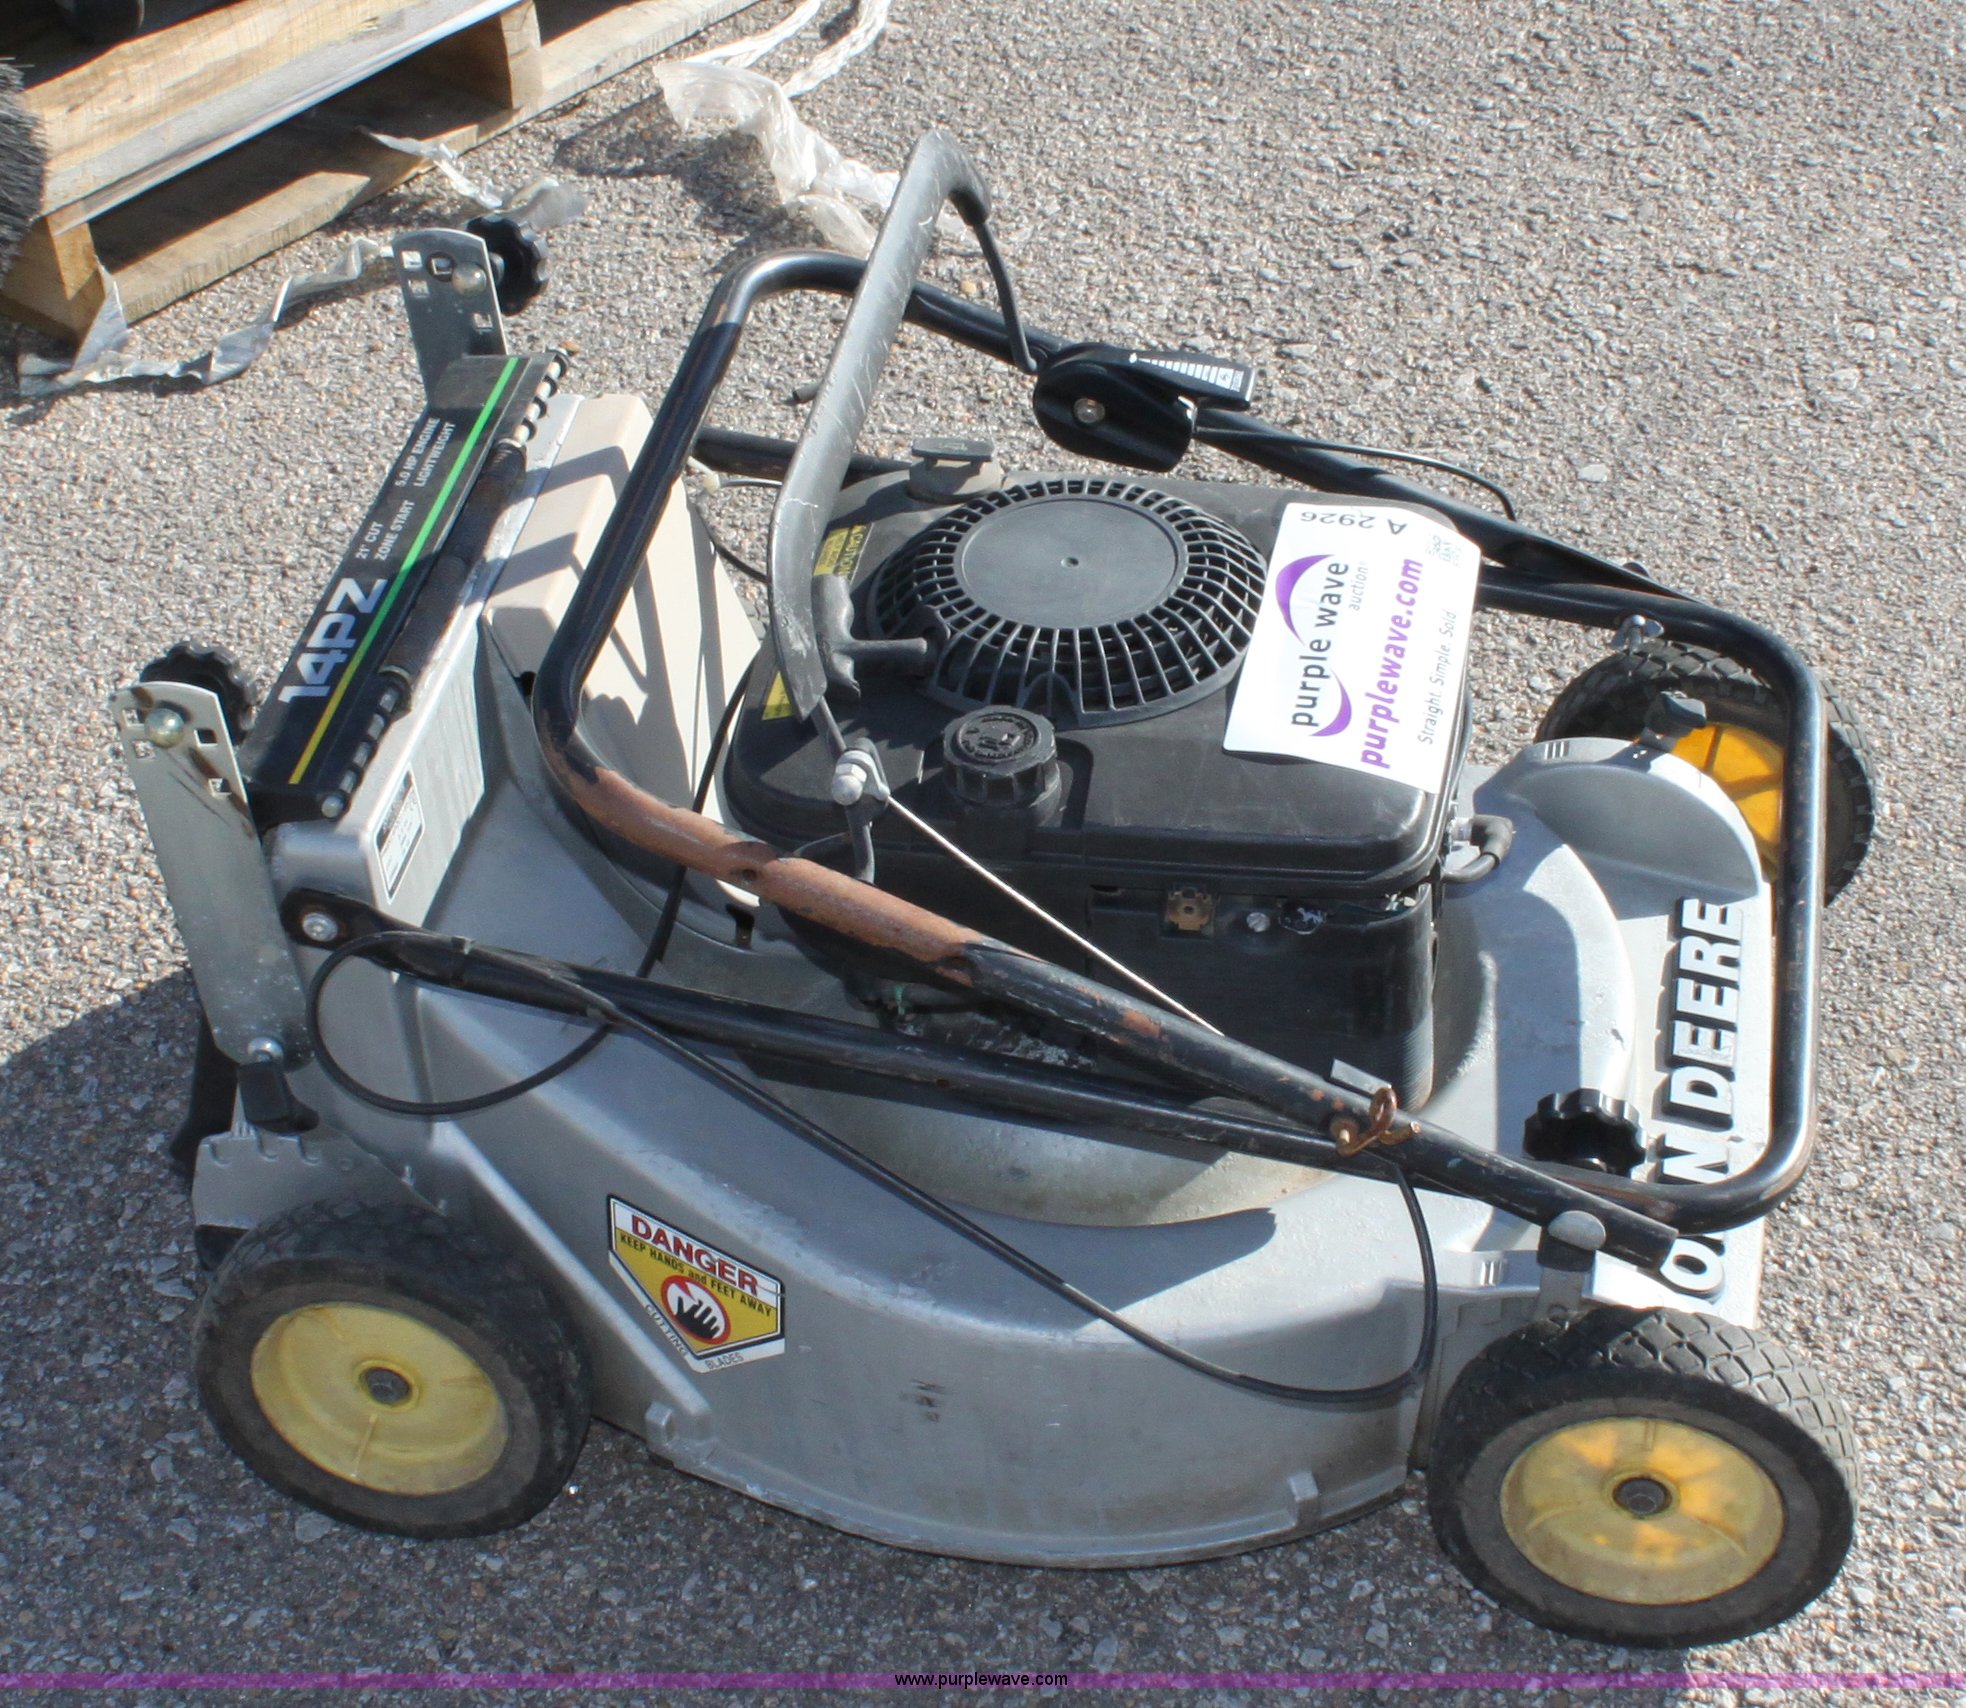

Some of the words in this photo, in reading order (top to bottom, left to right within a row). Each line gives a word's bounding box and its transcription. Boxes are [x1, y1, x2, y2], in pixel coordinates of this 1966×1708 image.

[412, 417, 441, 455] ENGINE
[413, 422, 456, 488] LIGHTWEIGHT
[395, 470, 410, 487] 5.0
[407, 455, 419, 471] HP
[365, 521, 384, 543] CUT
[374, 532, 399, 561] ZONE
[390, 500, 416, 532] START
[1300, 511, 1376, 529] 2926
[1387, 519, 1408, 535] A
[1349, 566, 1369, 611] auction
[279, 577, 389, 704] 14PZ
[1291, 639, 1332, 728] purple
[1315, 562, 1349, 628] wave
[1360, 559, 1423, 769] purplewave.com
[1668, 898, 1743, 1119] DEERE
[620, 1232, 646, 1252] KEEP
[650, 1249, 685, 1274] HANDS
[688, 1269, 708, 1286] and
[711, 1280, 737, 1301] FEET
[740, 1296, 772, 1317] AWAY
[632, 1215, 758, 1297] DANGER
[644, 1304, 688, 1357] CUTTING
[705, 1352, 745, 1371] BLADES
